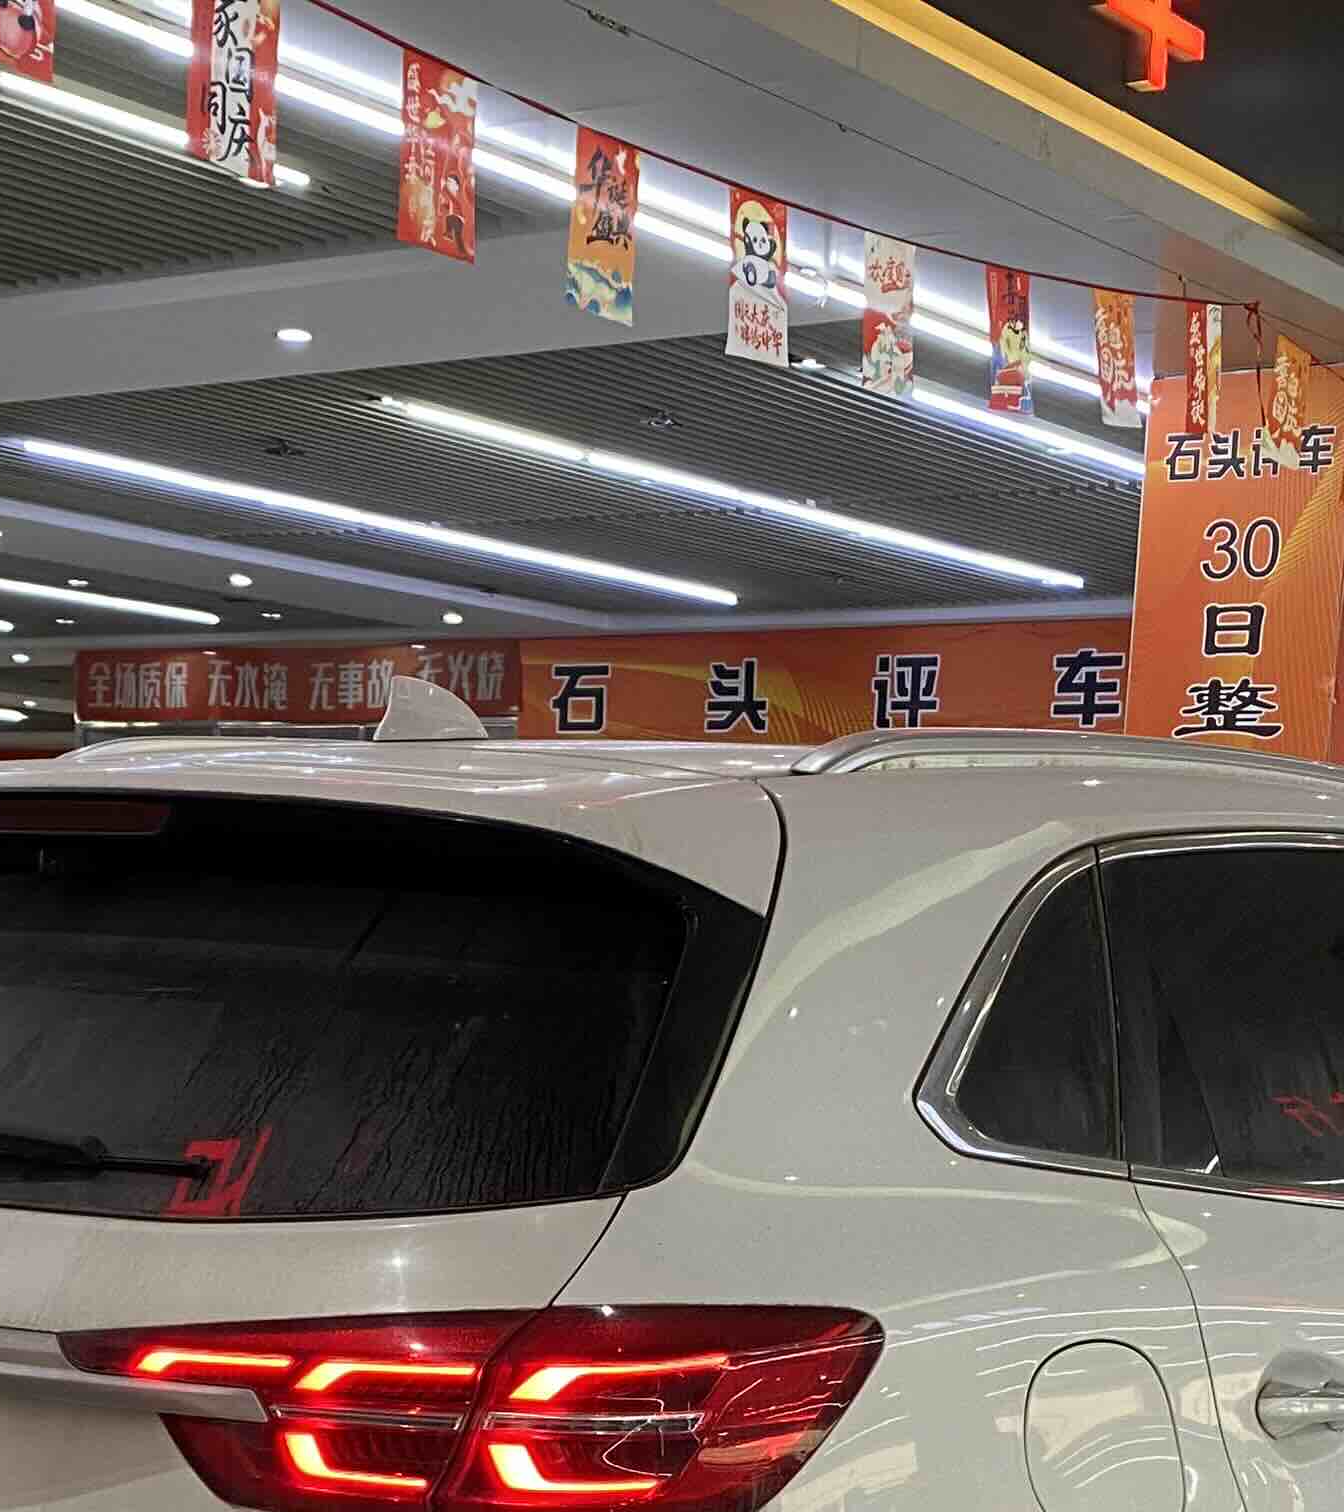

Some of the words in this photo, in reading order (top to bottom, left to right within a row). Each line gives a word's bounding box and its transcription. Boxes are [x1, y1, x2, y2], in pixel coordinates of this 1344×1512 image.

[87, 659, 188, 710] 全场质保
[308, 656, 394, 713] 无事故
